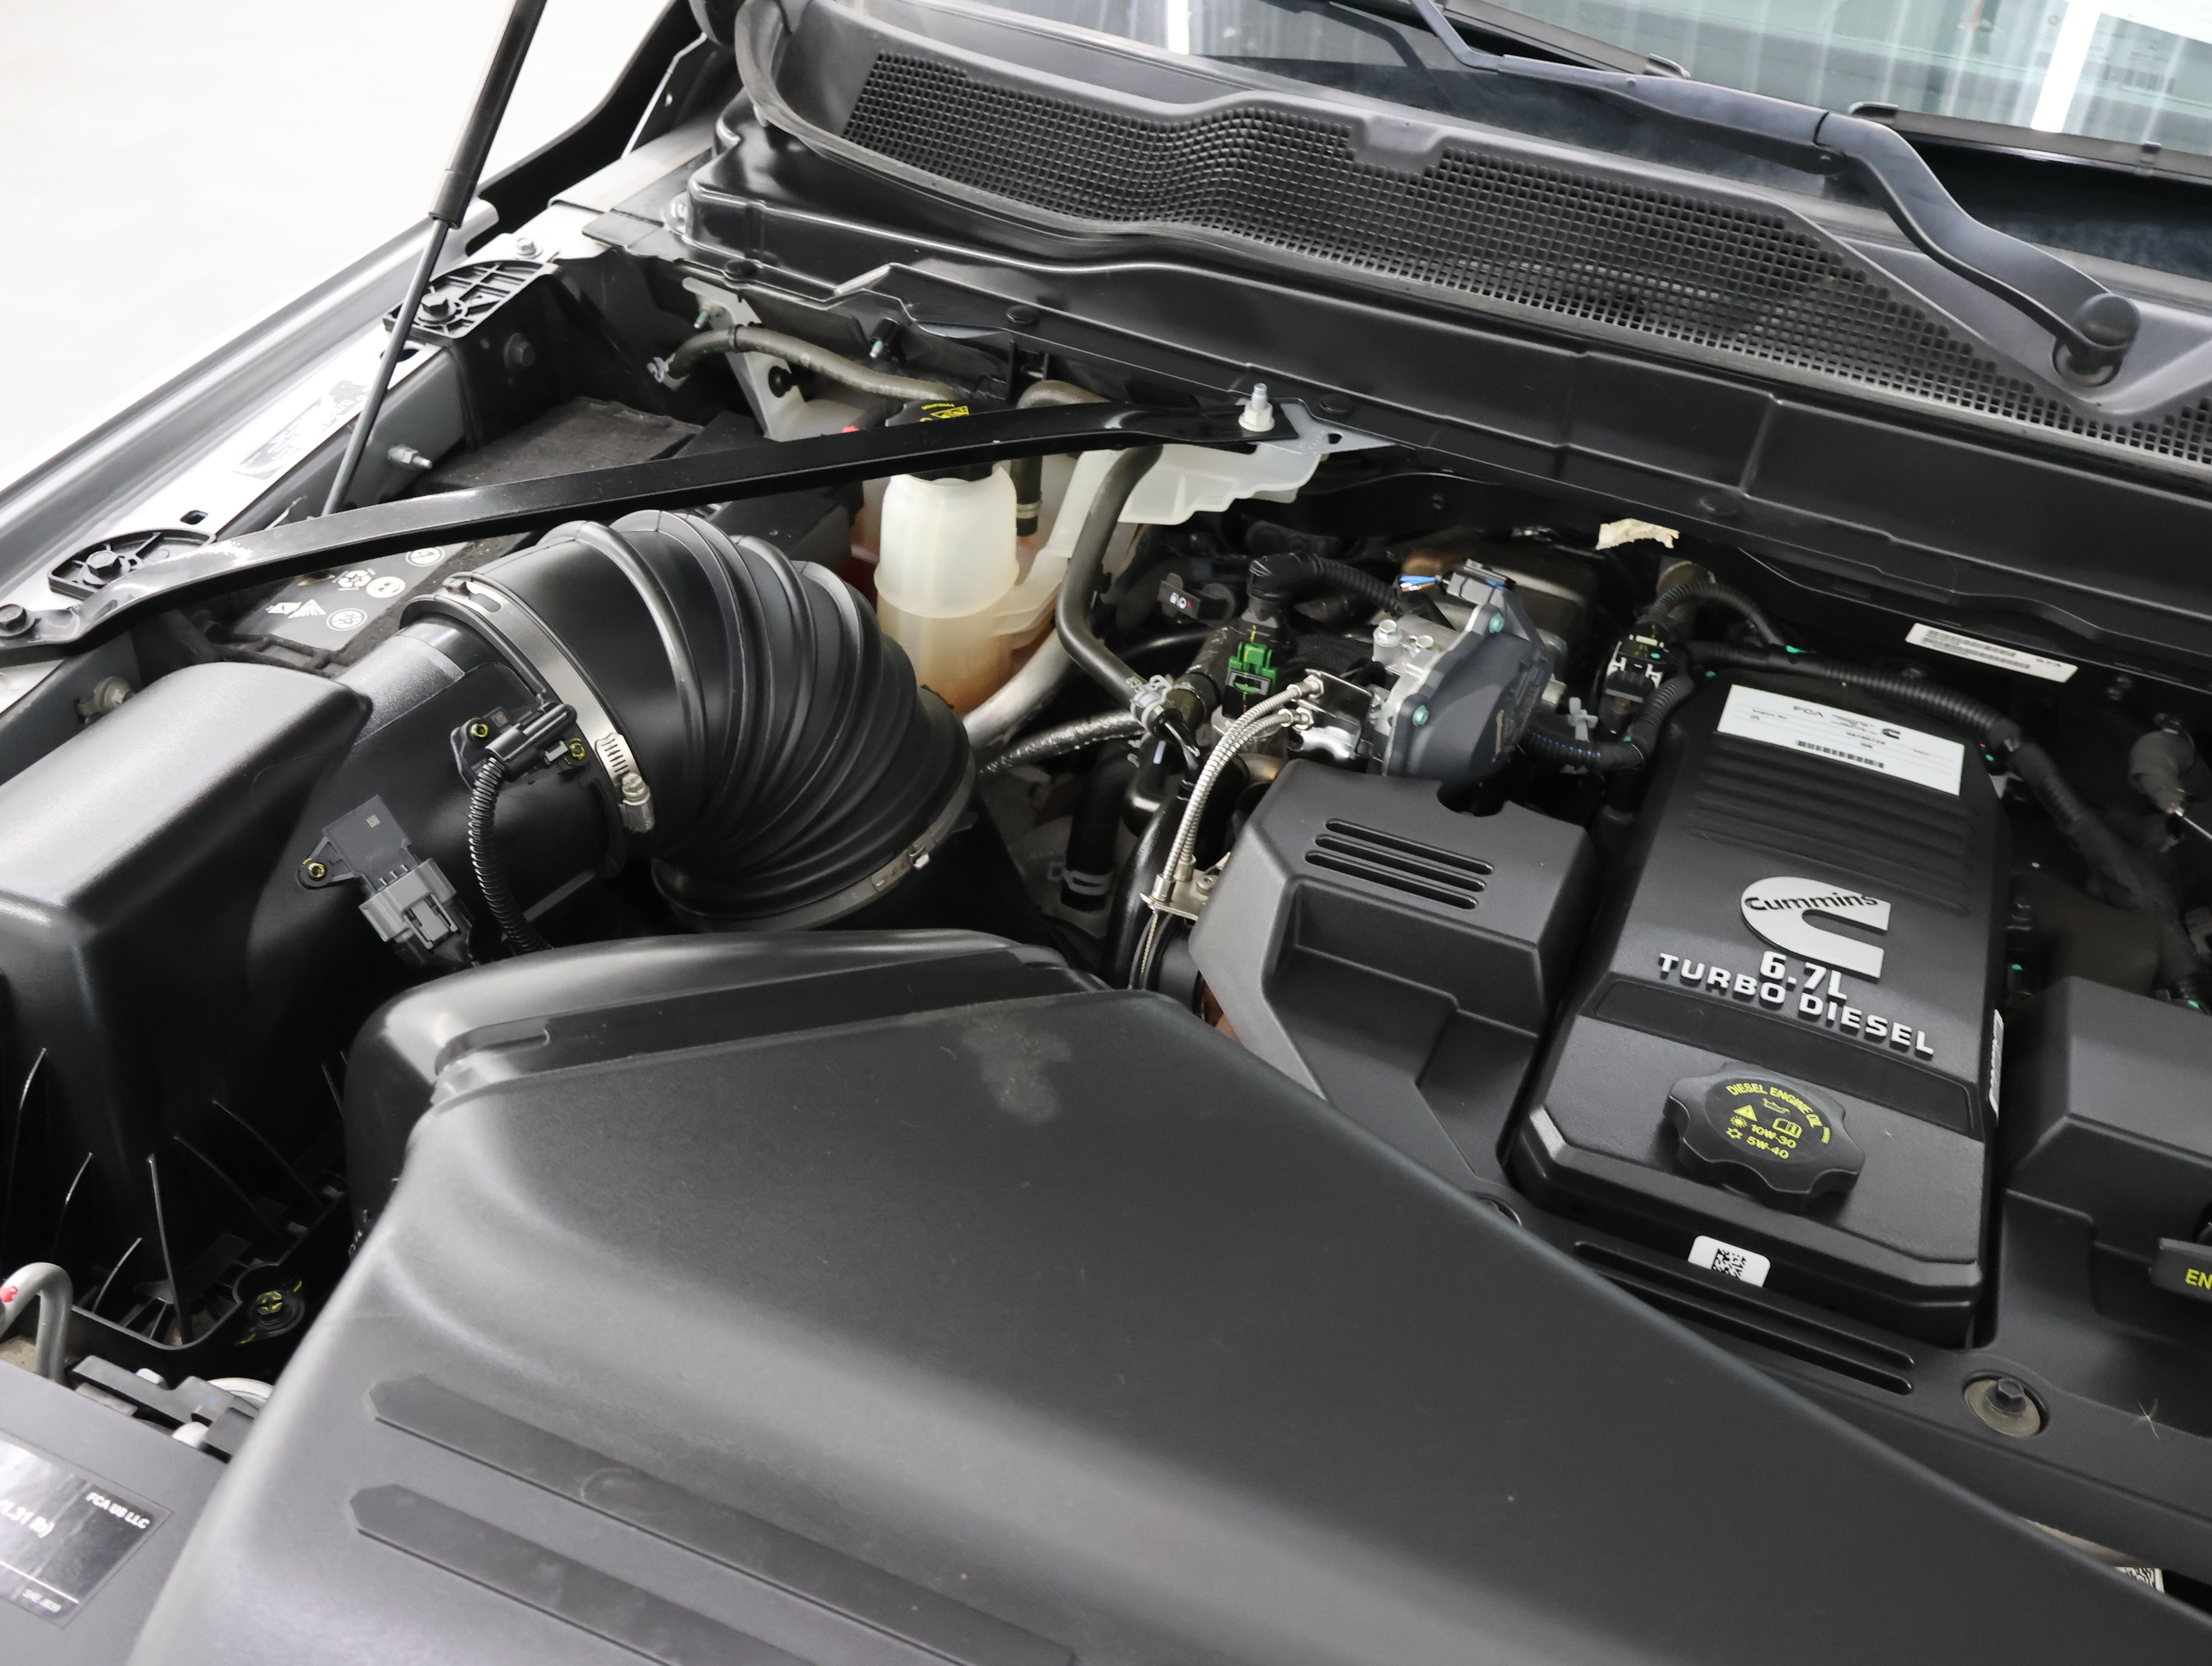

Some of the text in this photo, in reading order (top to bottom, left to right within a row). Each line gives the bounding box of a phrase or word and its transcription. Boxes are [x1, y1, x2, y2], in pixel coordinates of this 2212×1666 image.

[1745, 892, 1878, 911] Cummins
[1760, 951, 1848, 1000] 6.7L
[1659, 952, 1934, 1056] TURBO DIESEL
[1726, 1083, 1823, 1128] DIESEL ENGINE OIL
[1746, 1135, 1790, 1159] 5W-40
[1751, 1124, 1797, 1148] 10W-30
[2185, 1268, 2212, 1290] EN
[85, 1492, 150, 1529] FCA US LLC
